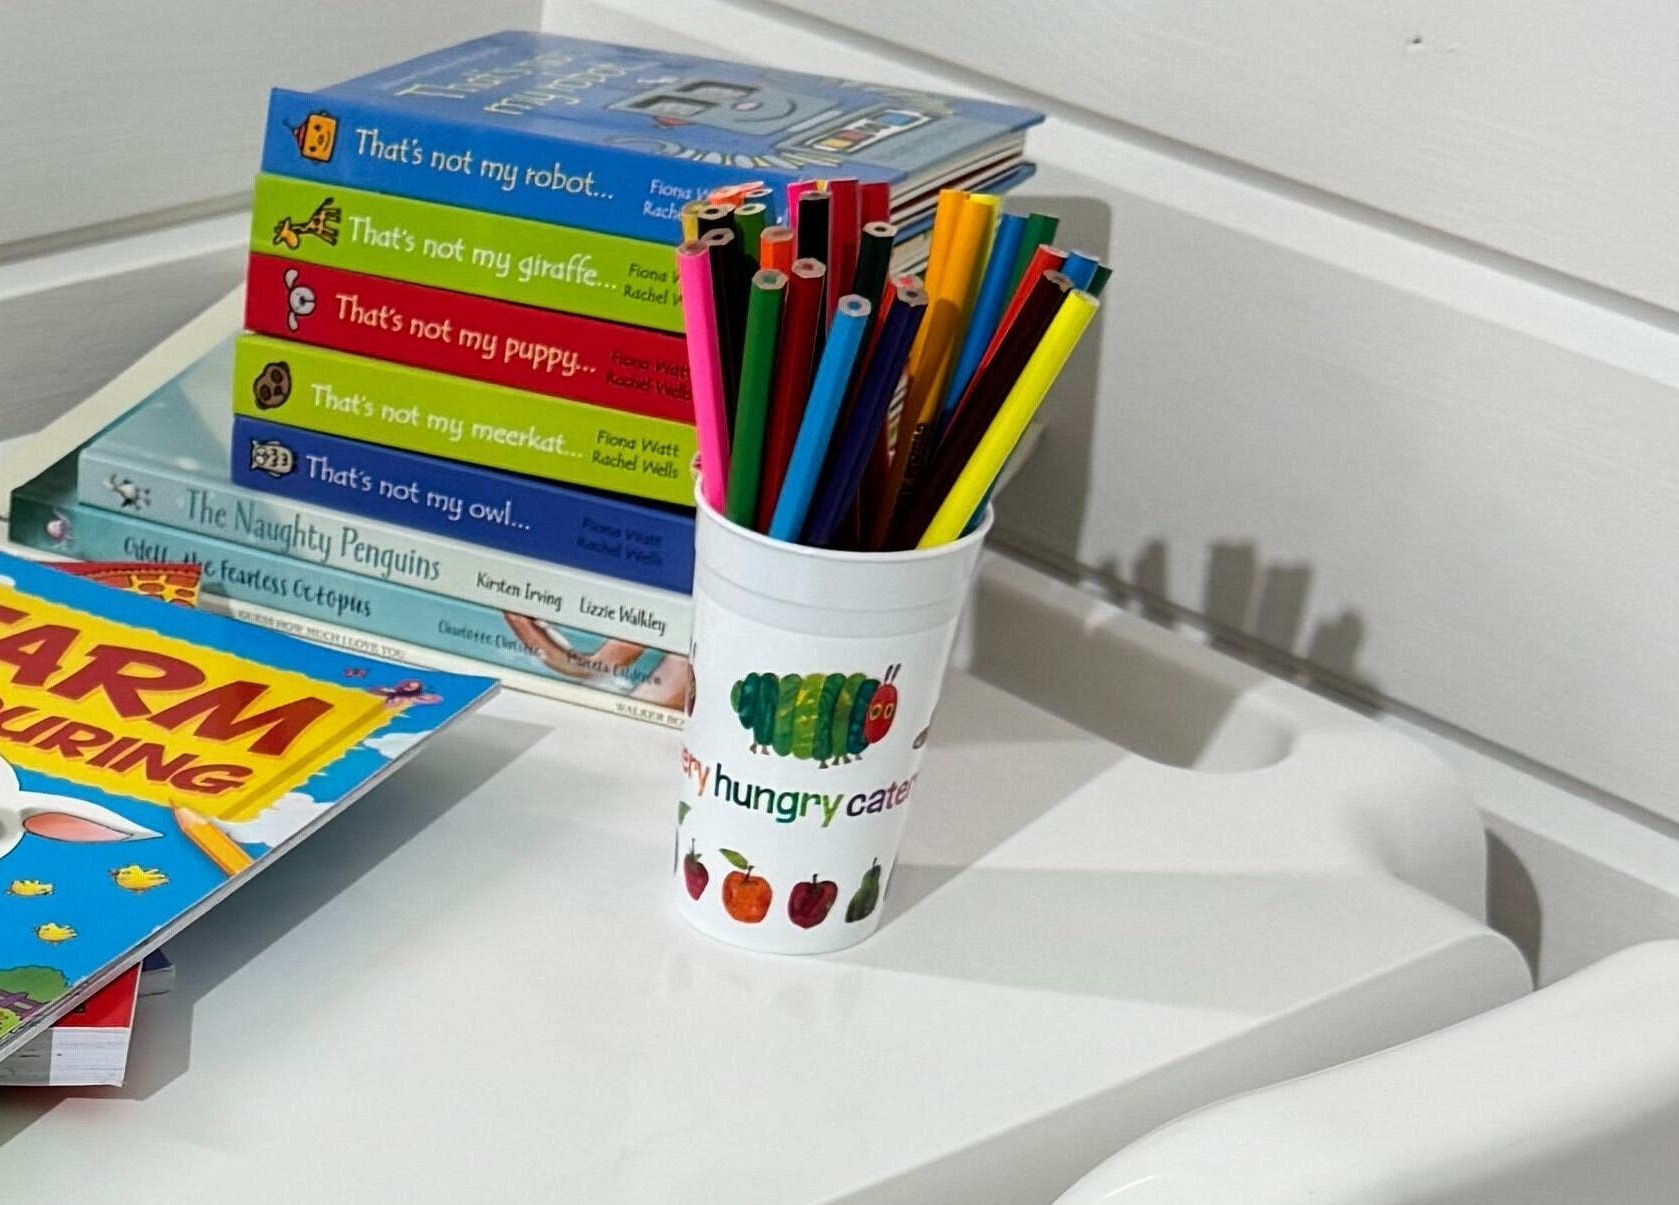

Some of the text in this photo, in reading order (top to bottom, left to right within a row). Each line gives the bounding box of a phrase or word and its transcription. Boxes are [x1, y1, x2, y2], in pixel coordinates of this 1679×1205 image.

[356, 128, 615, 200] That's not my robot...
[650, 179, 691, 199] Fiona
[643, 201, 682, 221] Rach
[348, 215, 618, 290] That's not my giraffe...
[629, 263, 667, 282] Fiona
[623, 285, 668, 305] Rachel
[335, 292, 597, 377] That's not my puppy...
[311, 384, 583, 458] That's not my meerkat...
[597, 430, 679, 458] Fiona Watt
[592, 450, 679, 480] Rachel Wells
[305, 455, 531, 531] That's not my owl...
[187, 487, 441, 581] The Naughty Penguins
[293, 578, 372, 617] Octopus
[477, 572, 666, 637] Kirsten Irving Lizzie Walkley
[276, 618, 303, 633] HOW
[348, 636, 379, 652] LOVE
[616, 703, 664, 720] WALKER
[682, 747, 919, 828] ery hungry cater
